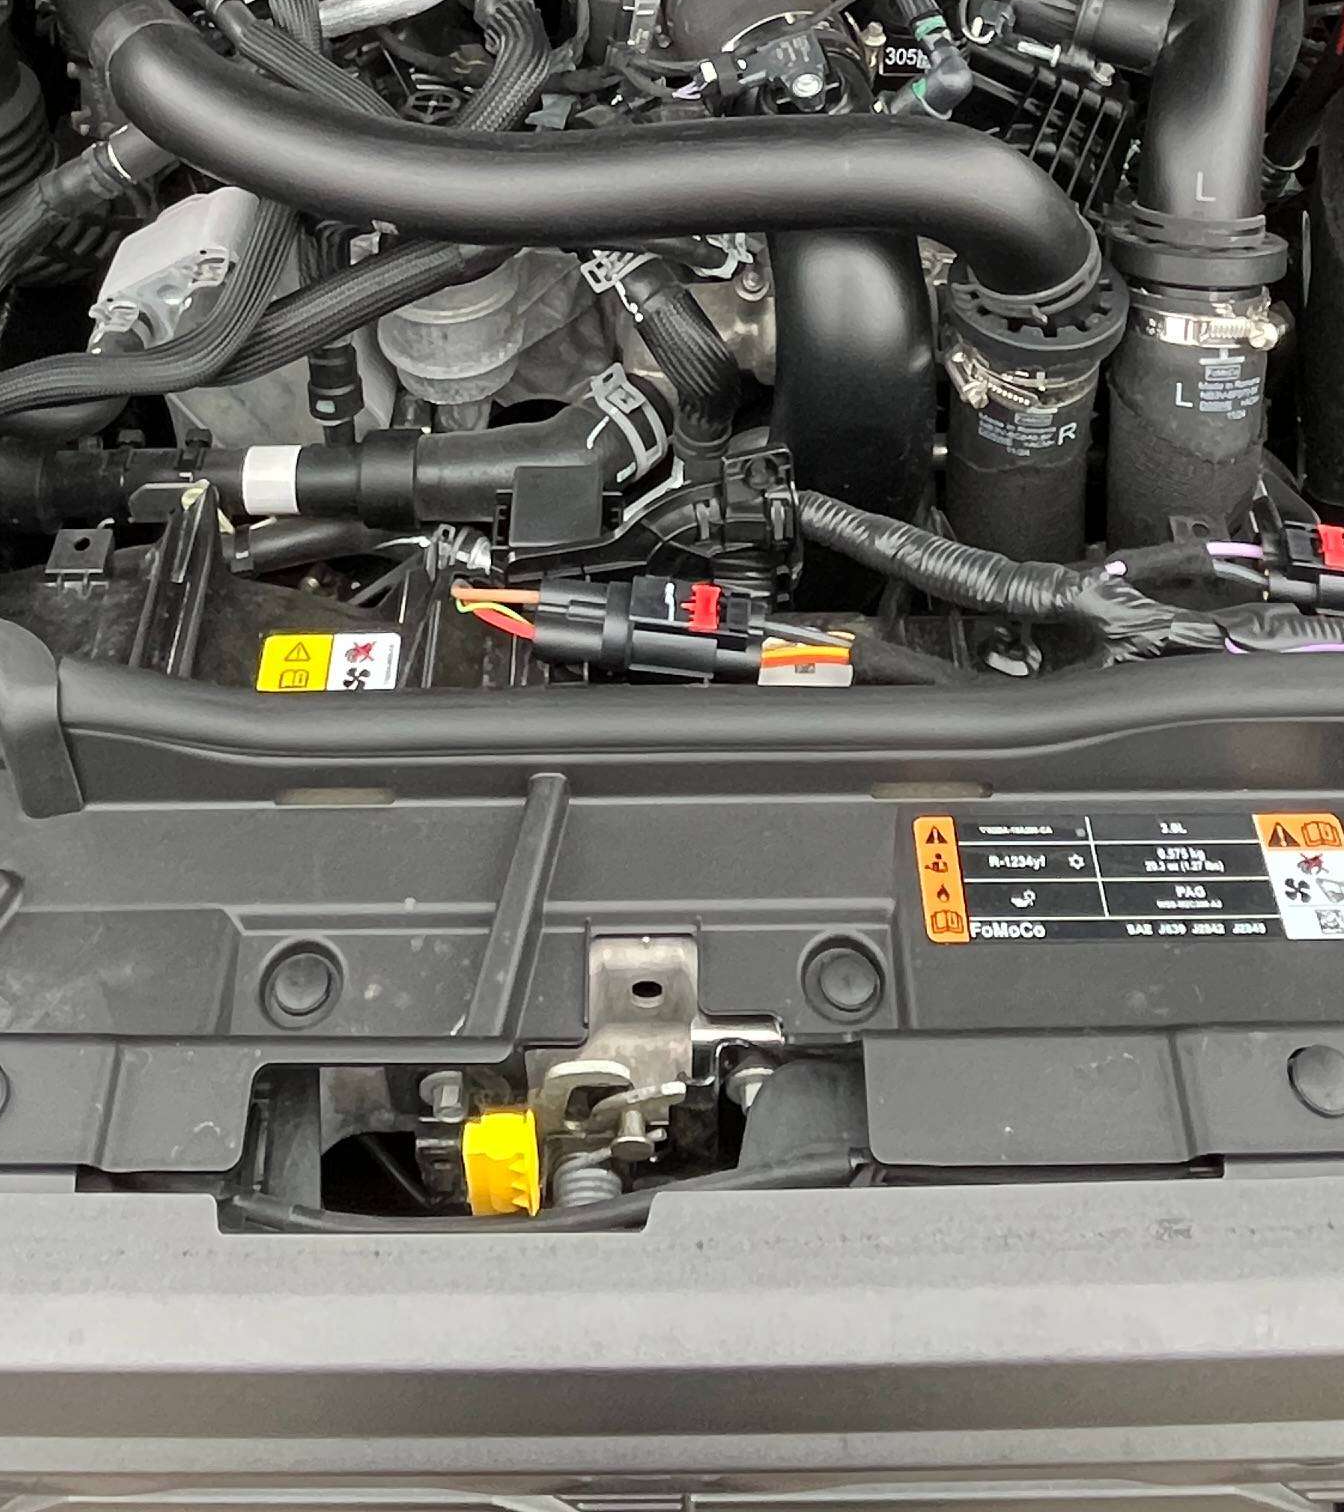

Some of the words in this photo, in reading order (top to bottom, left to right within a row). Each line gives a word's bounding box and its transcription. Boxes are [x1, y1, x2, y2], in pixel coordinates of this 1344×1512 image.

[1194, 171, 1216, 203] L
[1174, 382, 1194, 409] L
[1057, 422, 1078, 446] R
[970, 921, 1047, 939] FoMoCo
